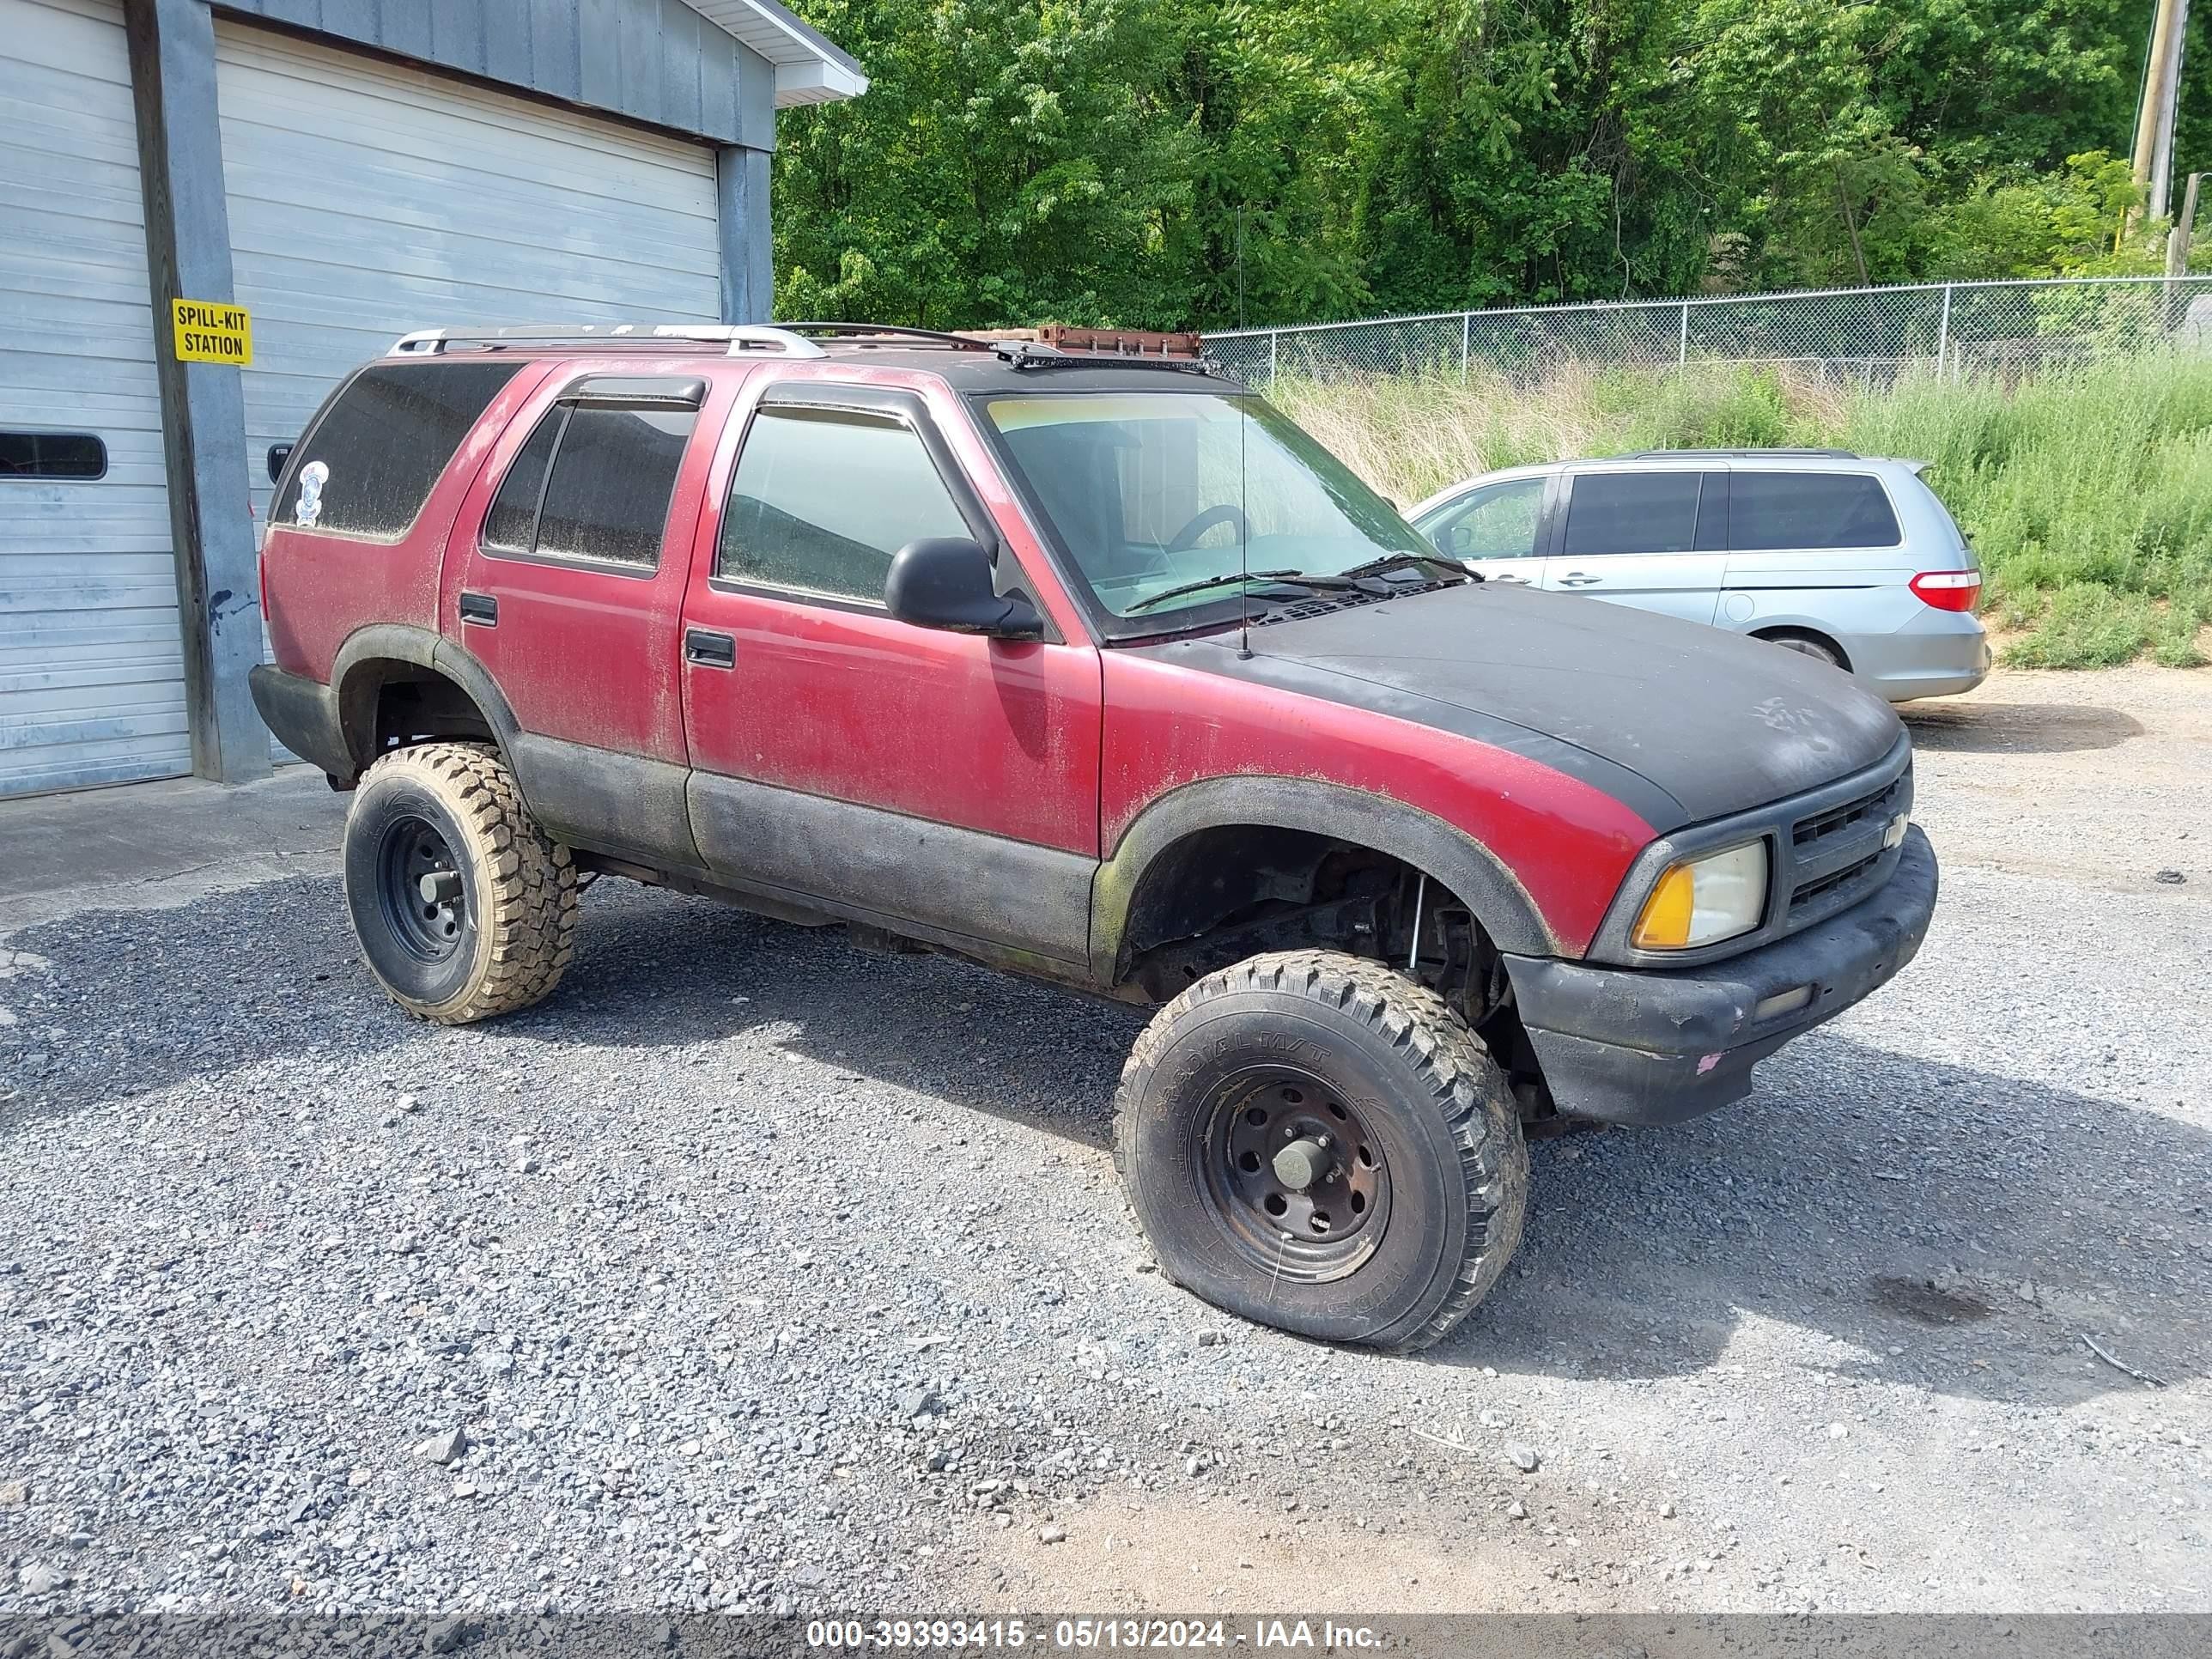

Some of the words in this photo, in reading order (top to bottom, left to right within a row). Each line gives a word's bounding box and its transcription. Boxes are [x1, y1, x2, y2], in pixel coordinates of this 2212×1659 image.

[178, 306, 246, 331] SPILL-KIT
[185, 332, 243, 356] STATION
[1260, 1031, 1332, 1062] M/T
